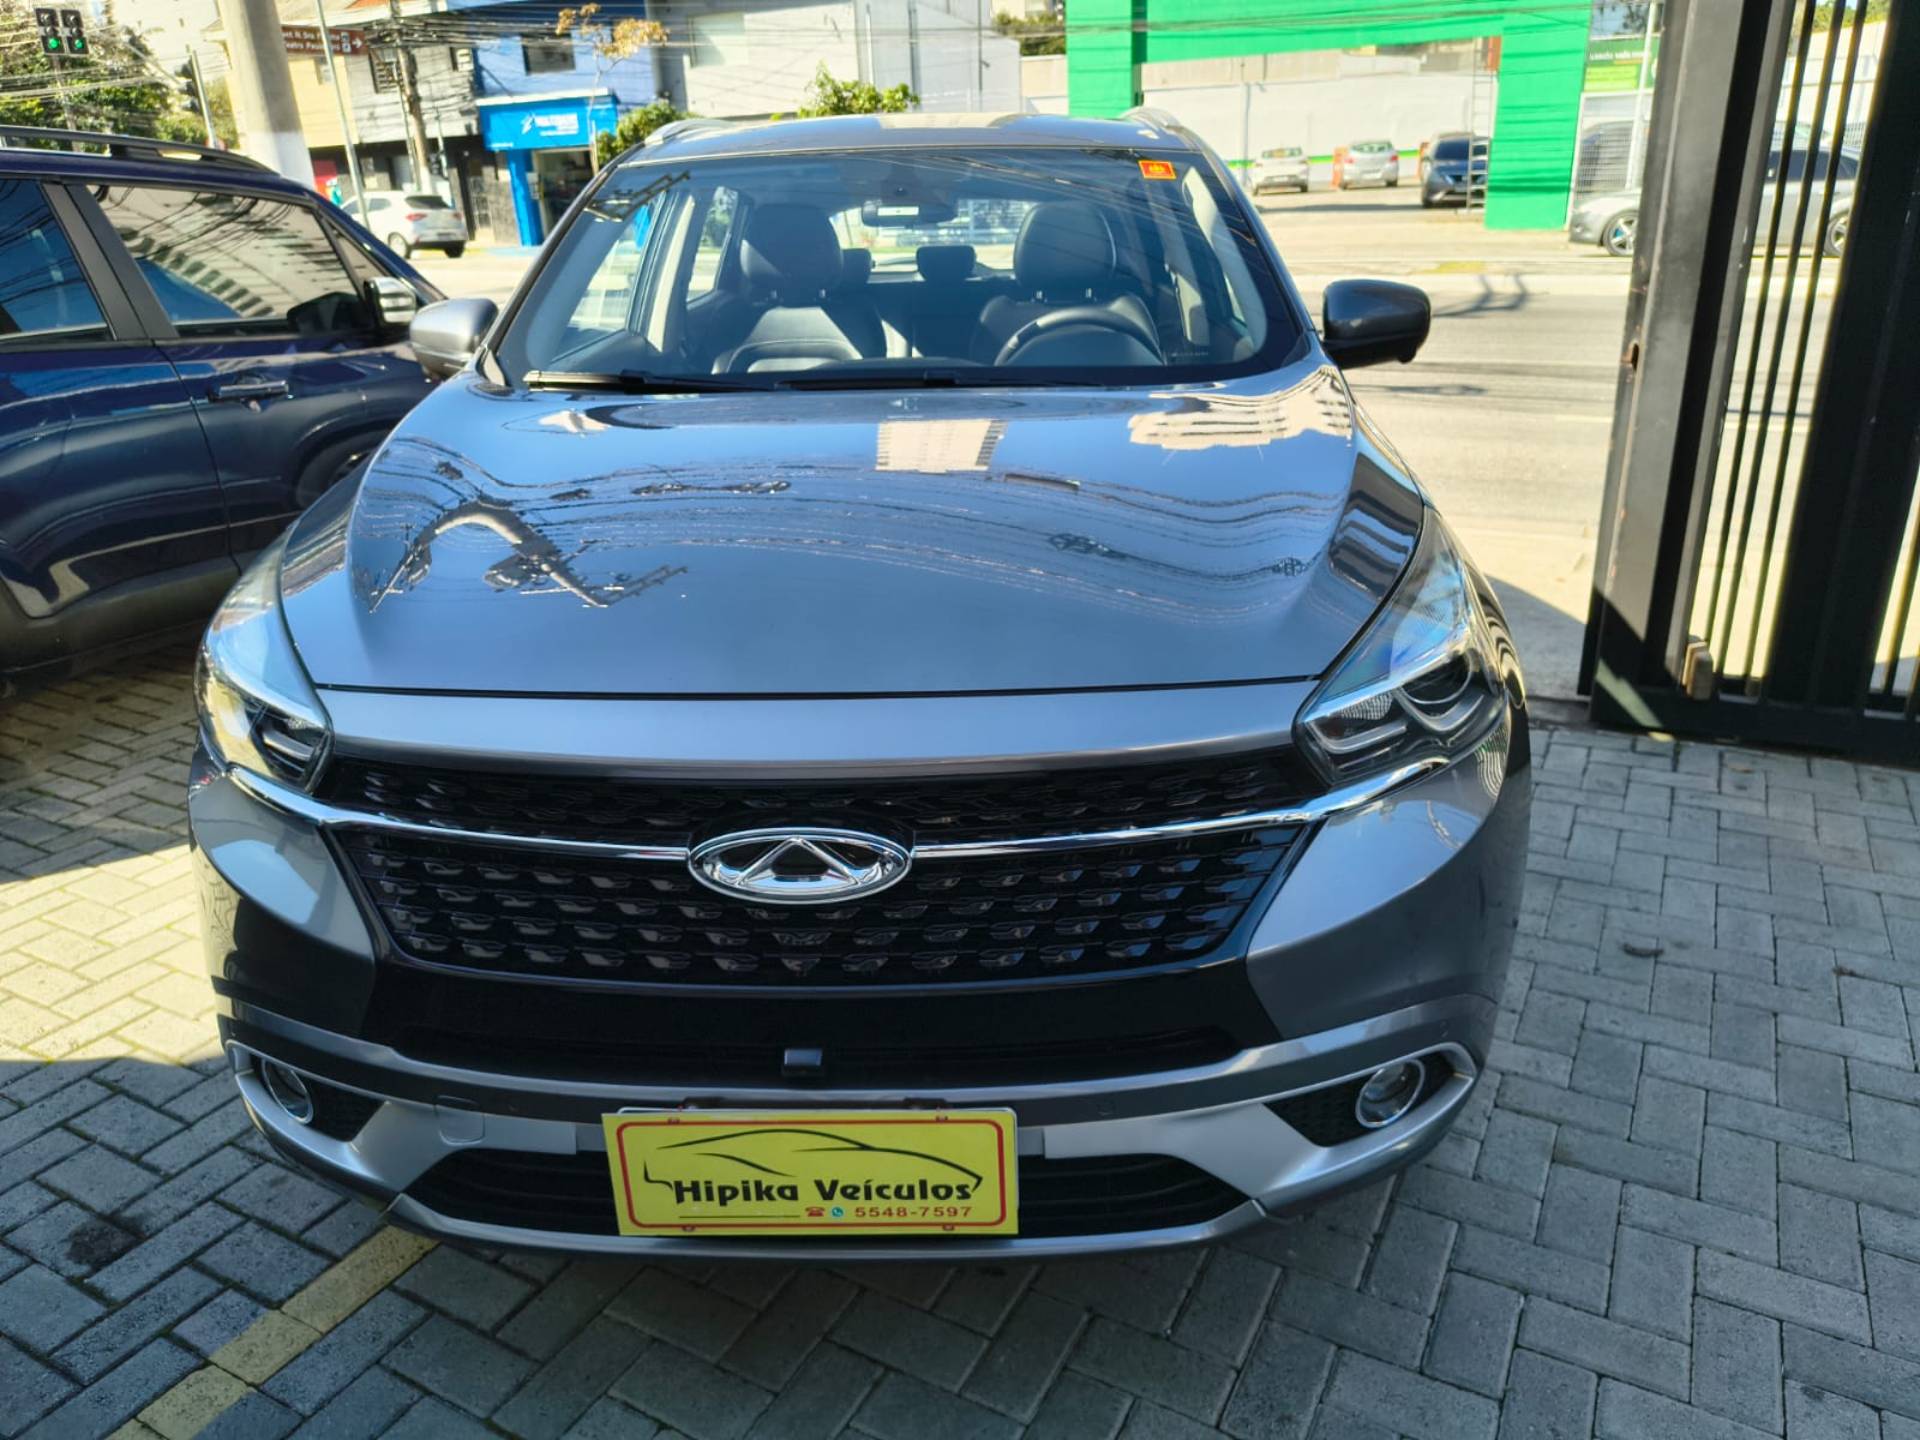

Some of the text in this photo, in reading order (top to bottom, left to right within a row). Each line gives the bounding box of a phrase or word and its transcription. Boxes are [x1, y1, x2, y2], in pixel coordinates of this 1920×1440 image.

[673, 1179, 972, 1207] Hipika Veículos
[855, 1206, 972, 1217] 5548-7597
